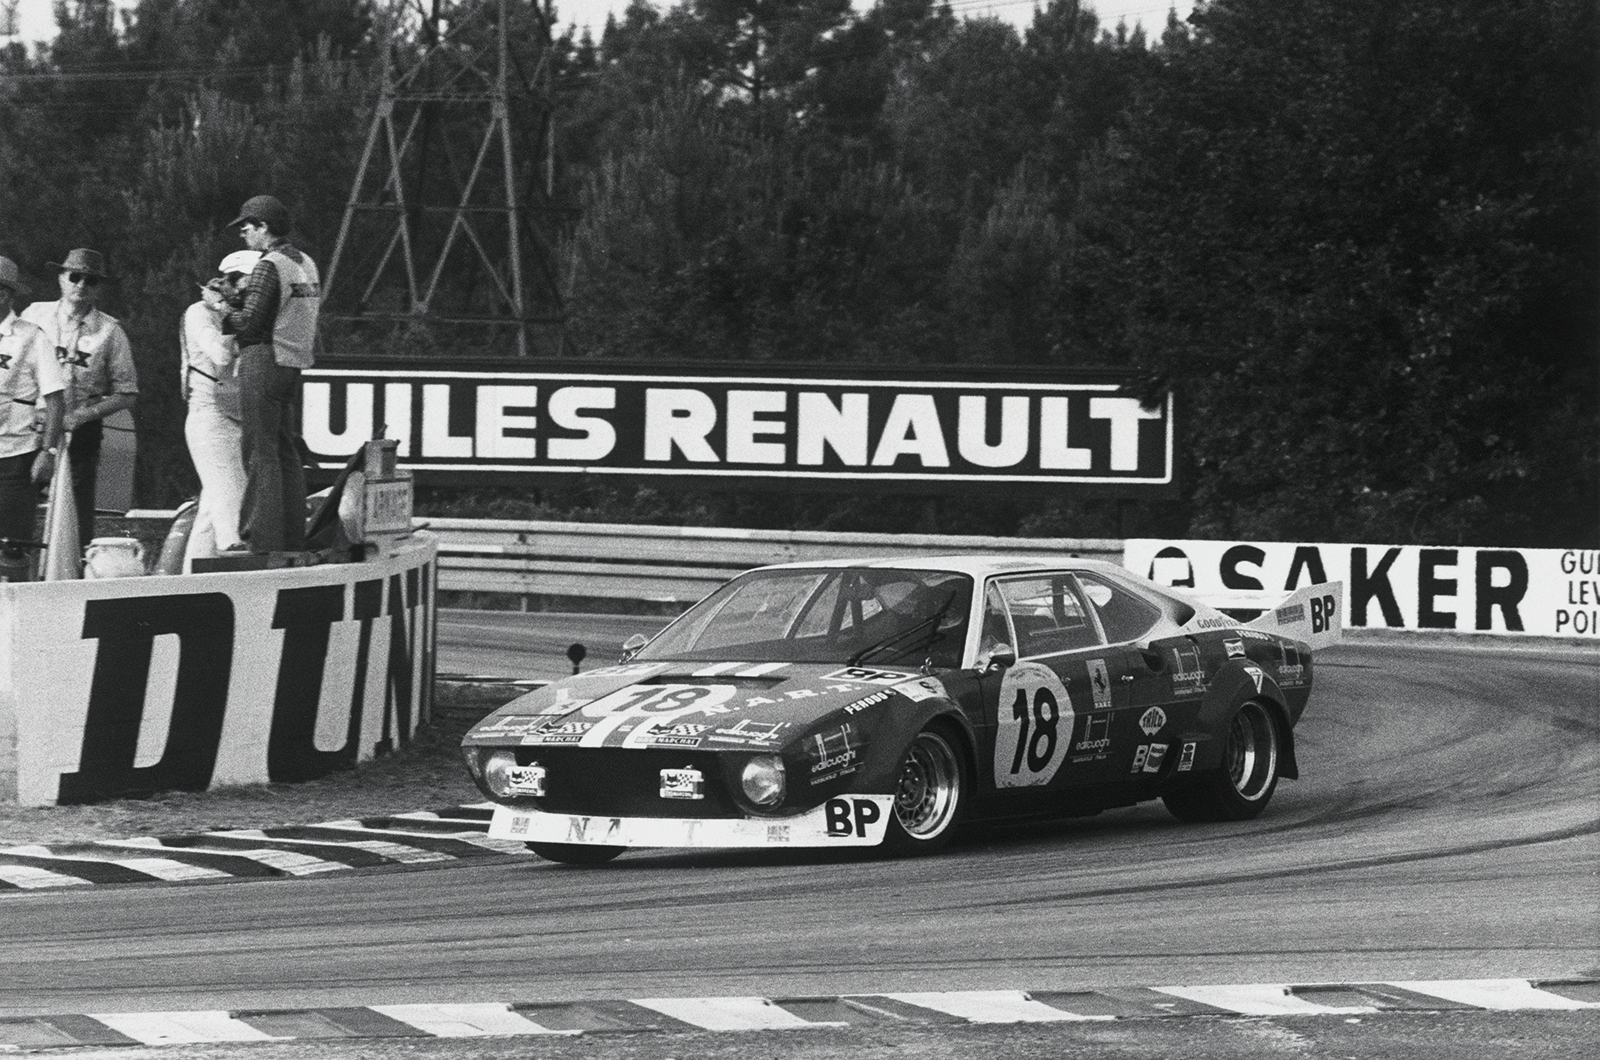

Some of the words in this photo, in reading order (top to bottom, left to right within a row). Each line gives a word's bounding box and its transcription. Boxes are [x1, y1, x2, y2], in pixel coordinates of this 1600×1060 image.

[644, 388, 1163, 471] RENAULT
[1310, 594, 1336, 634] BP
[1556, 609, 1597, 635] POI
[611, 687, 713, 713] 18
[844, 691, 889, 715] FERODO
[1012, 686, 1060, 775] 18
[825, 799, 881, 838] BP
